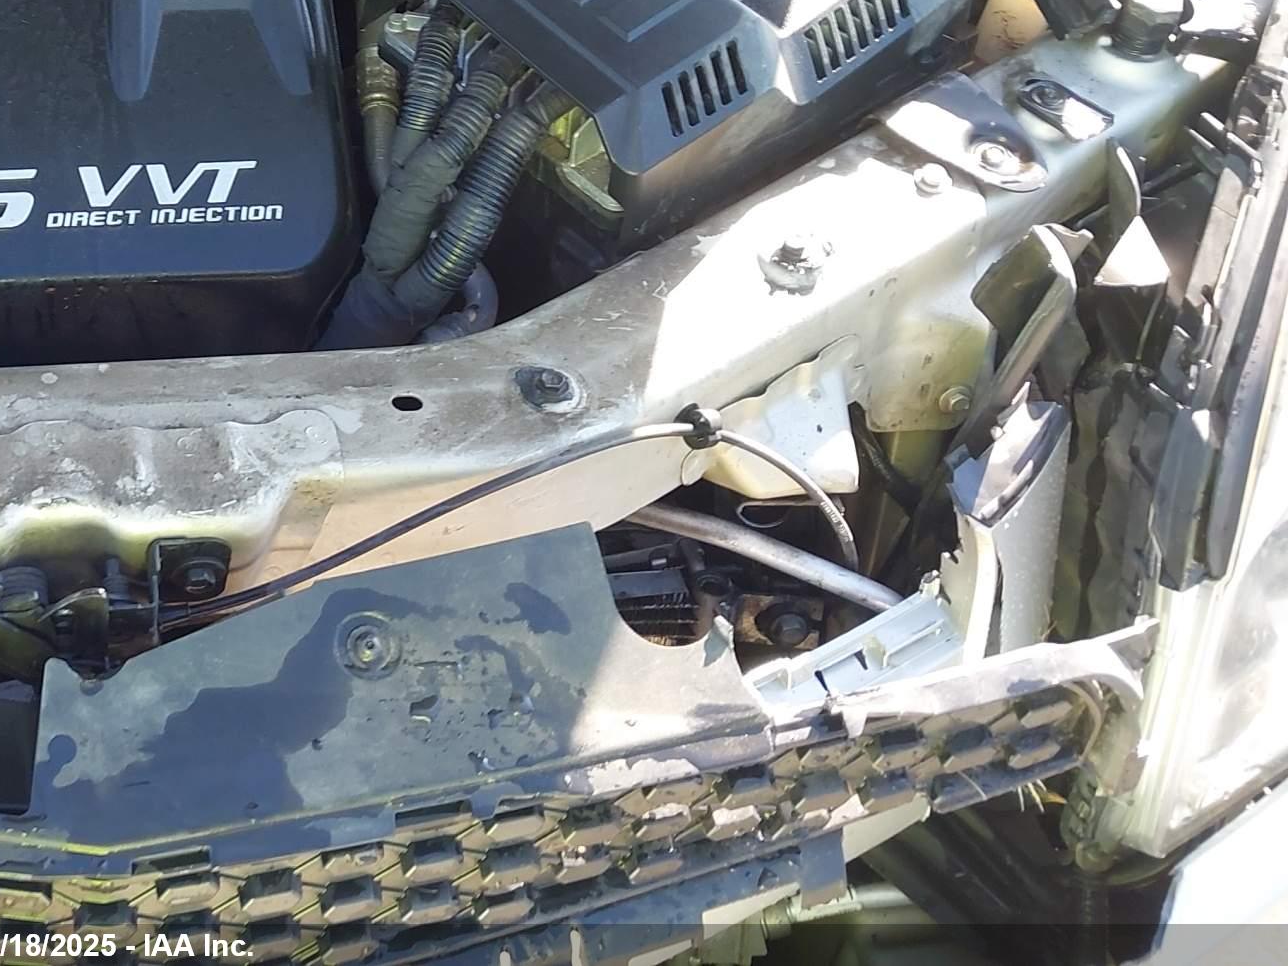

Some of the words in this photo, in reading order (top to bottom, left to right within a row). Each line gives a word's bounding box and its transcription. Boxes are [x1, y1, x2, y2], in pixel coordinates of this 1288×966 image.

[78, 160, 258, 207] VVT
[46, 208, 141, 228] DIRECT
[150, 199, 283, 225] INJECTION
